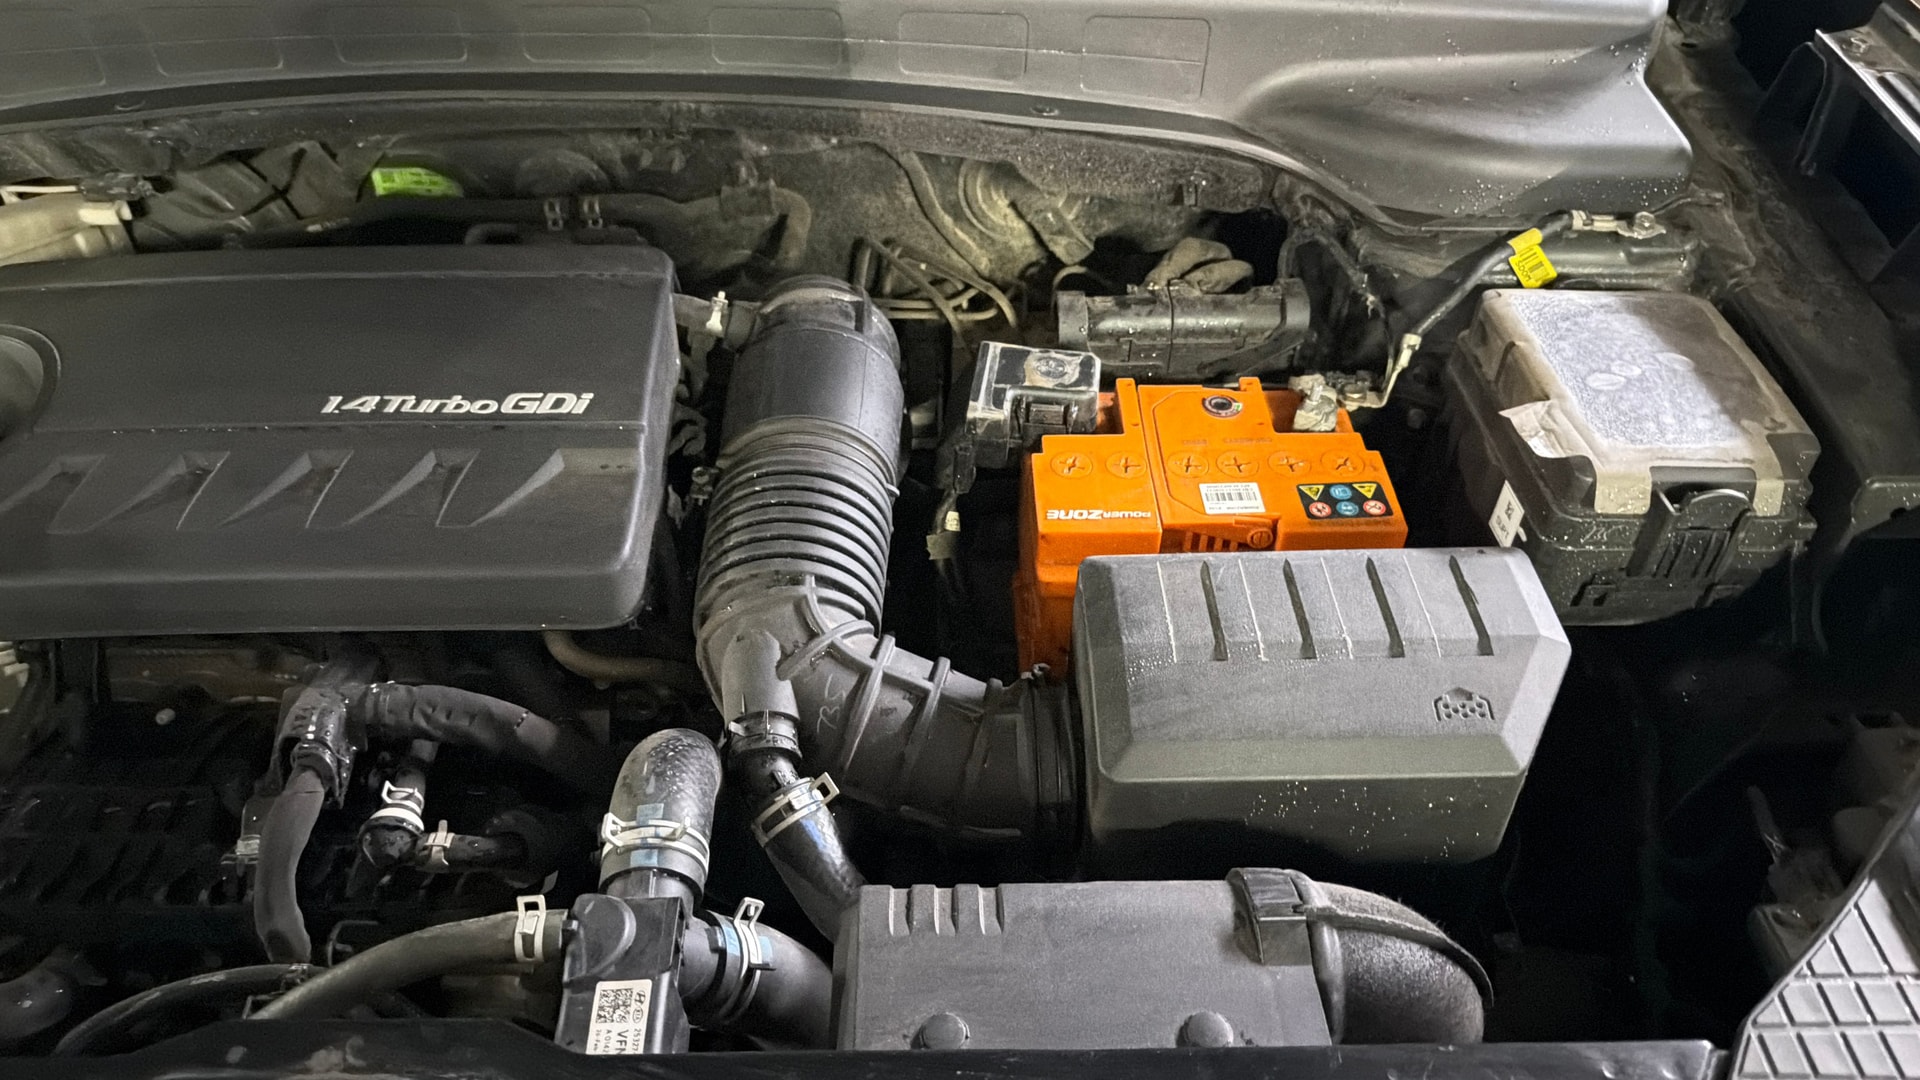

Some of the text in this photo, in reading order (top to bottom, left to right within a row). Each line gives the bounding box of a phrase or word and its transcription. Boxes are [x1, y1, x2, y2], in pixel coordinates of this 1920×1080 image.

[321, 392, 595, 414] 1.4 Turbo GDi
